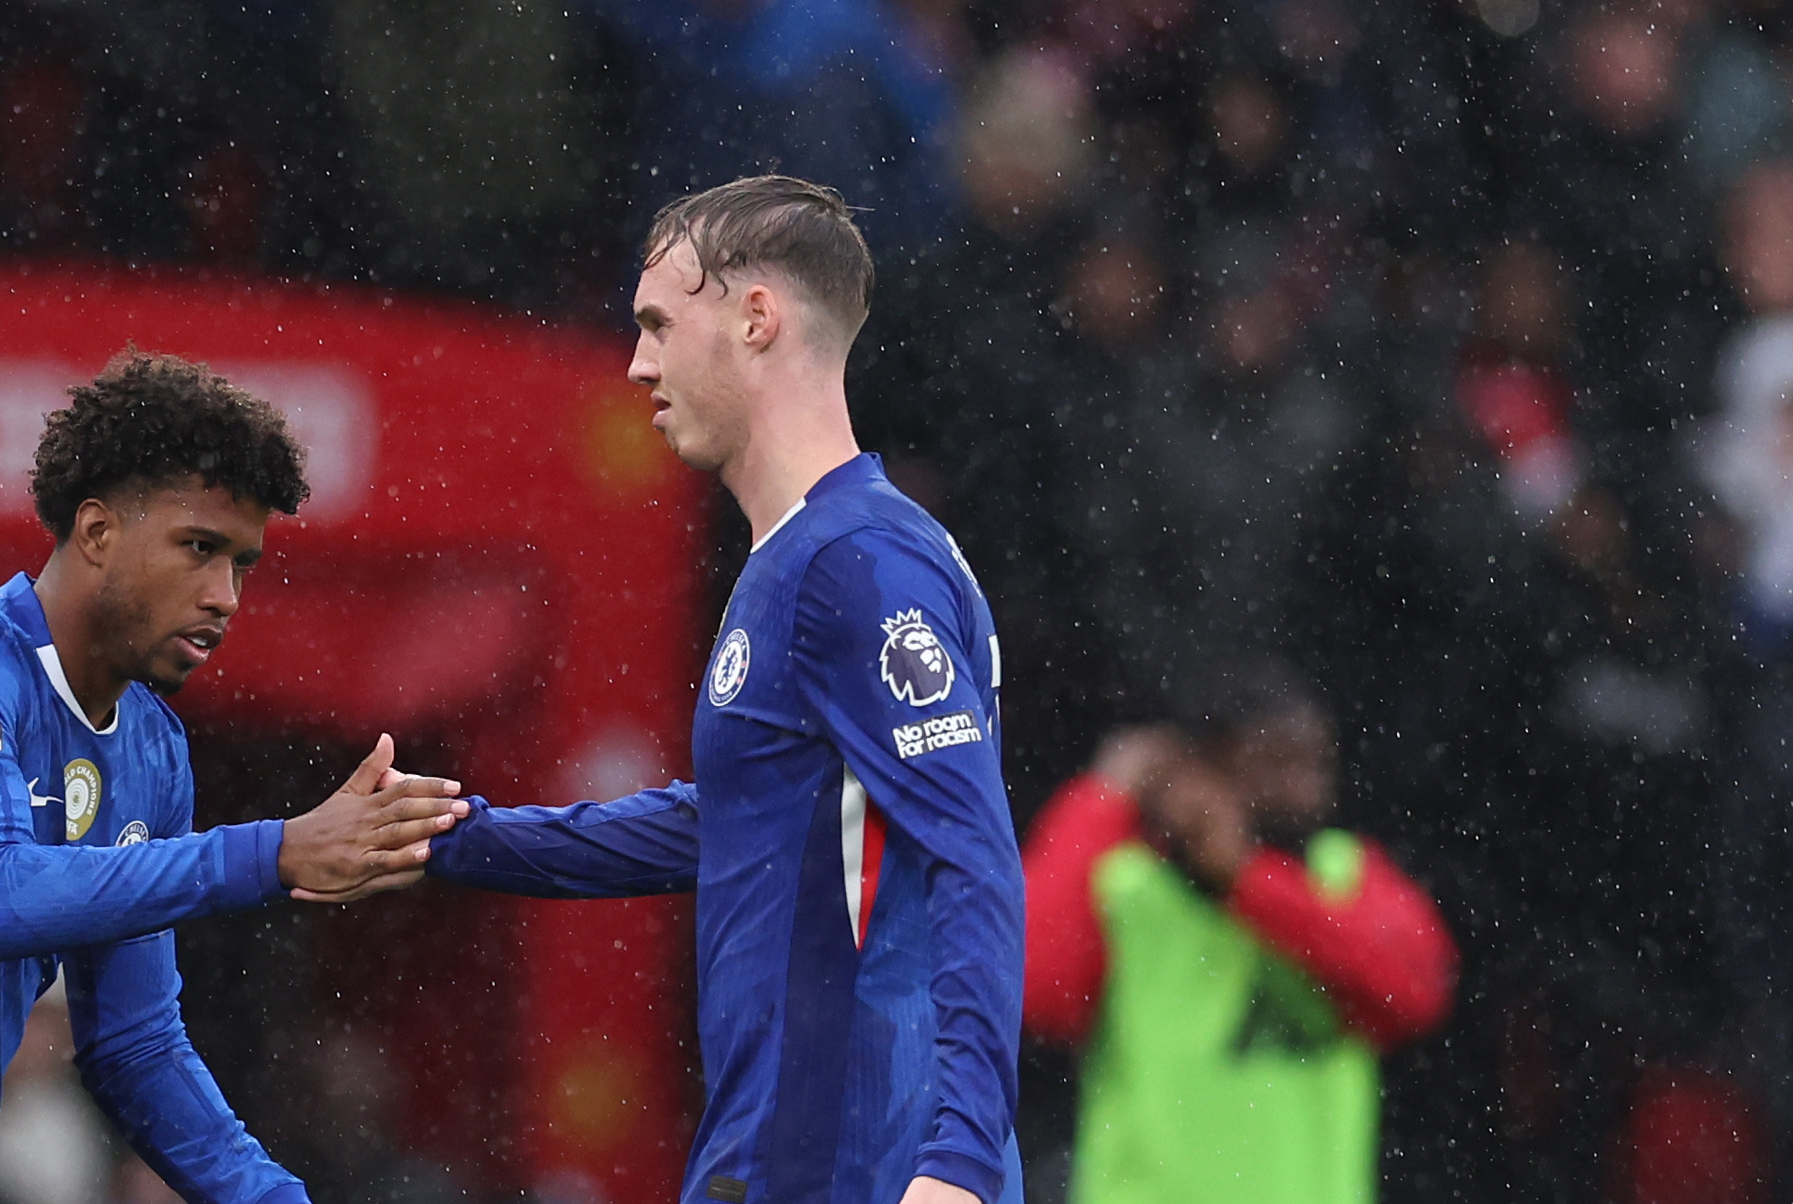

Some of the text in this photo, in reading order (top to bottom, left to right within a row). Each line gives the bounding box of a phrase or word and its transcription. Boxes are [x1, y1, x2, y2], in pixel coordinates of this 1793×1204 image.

[892, 714, 971, 746] No room
[897, 727, 982, 759] for racism
